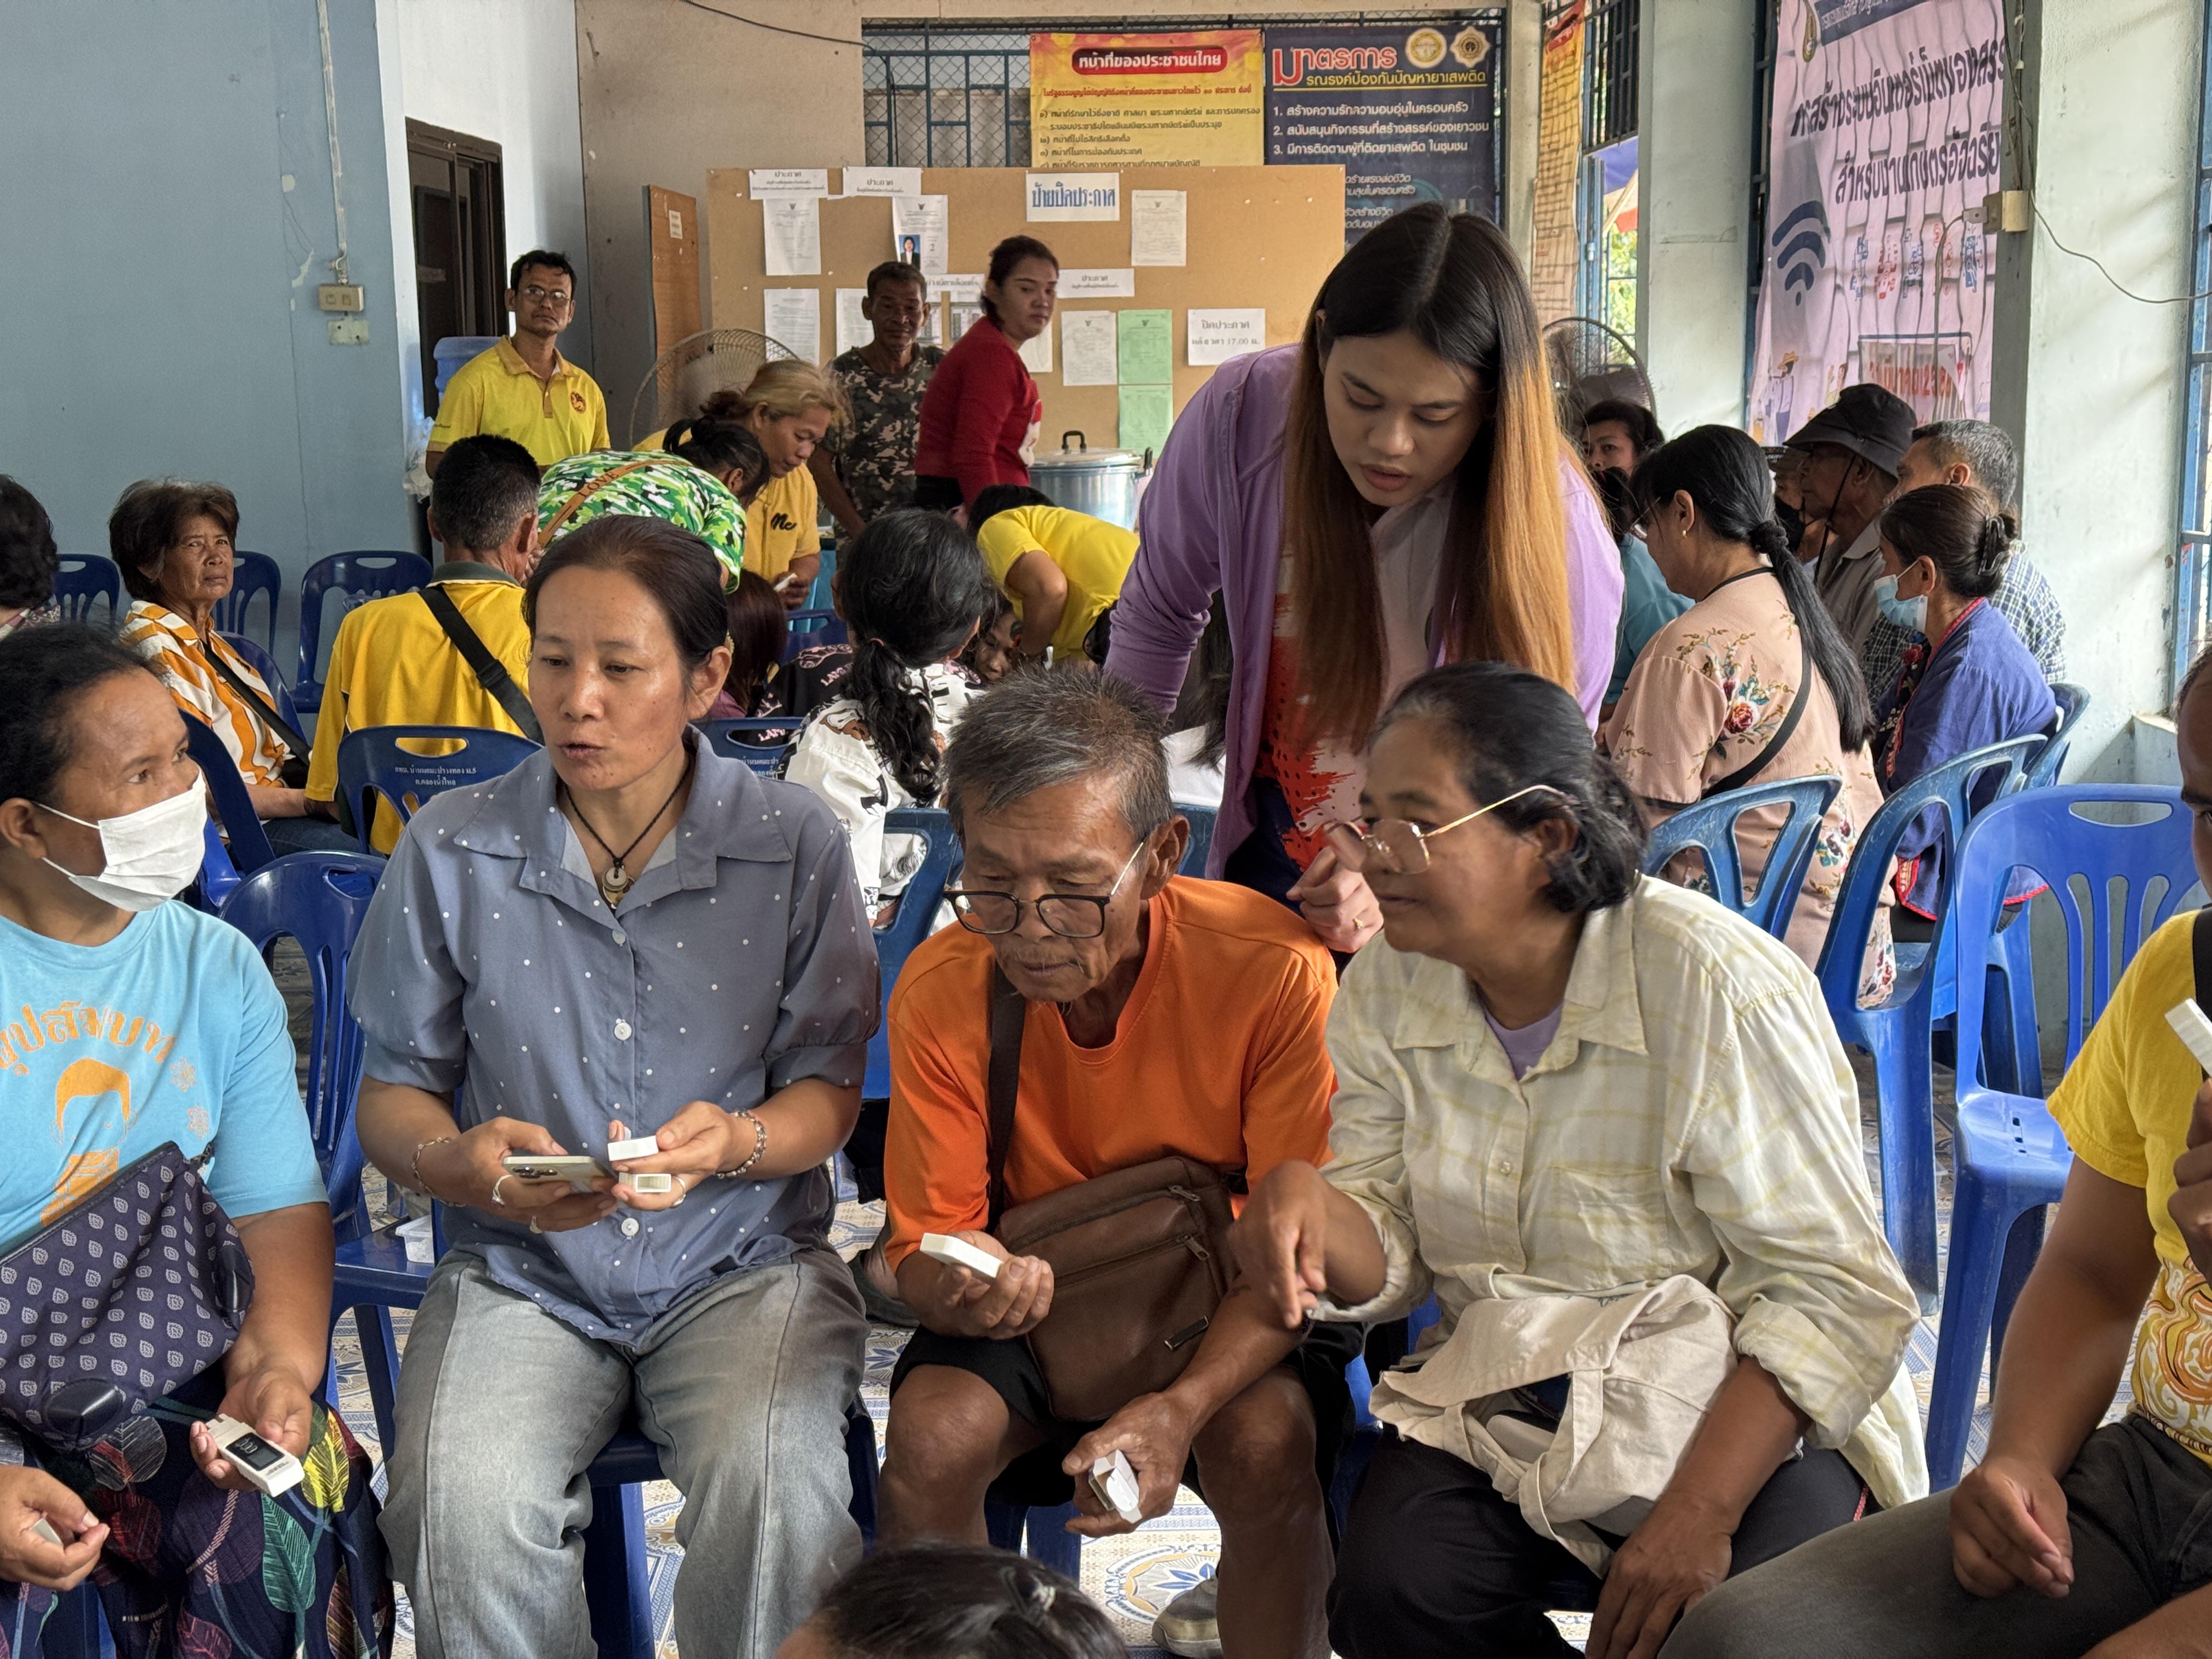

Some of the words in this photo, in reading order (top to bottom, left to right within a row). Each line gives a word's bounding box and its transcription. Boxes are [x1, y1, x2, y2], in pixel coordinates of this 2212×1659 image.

[1079, 50, 1222, 69] หน้าที่ของประชาชนไทย
[1272, 47, 1398, 86] มาตรการ
[1306, 70, 1486, 86] รณรงค์ป้องกันปัญหายาเสพติด
[1273, 106, 1283, 116] 1.
[1286, 101, 1469, 117] สร้างความรักความอบอุ่นในครอบครัว
[1273, 126, 1283, 136] 2.
[1287, 121, 1489, 138] สนับสนุนกิจกรรมที่สร้างสรรค์ของเยาวชน
[1273, 144, 1283, 155] 3.
[1288, 139, 1426, 156] มีการติดตามผู้ที่ติดยาเสพติด
[1429, 138, 1469, 154] ในชุมชน
[1032, 181, 1115, 208] ป้ายปิดประกาศ
[1201, 319, 1250, 329] ปิดประกาศ
[577, 472, 619, 497] LOVE
